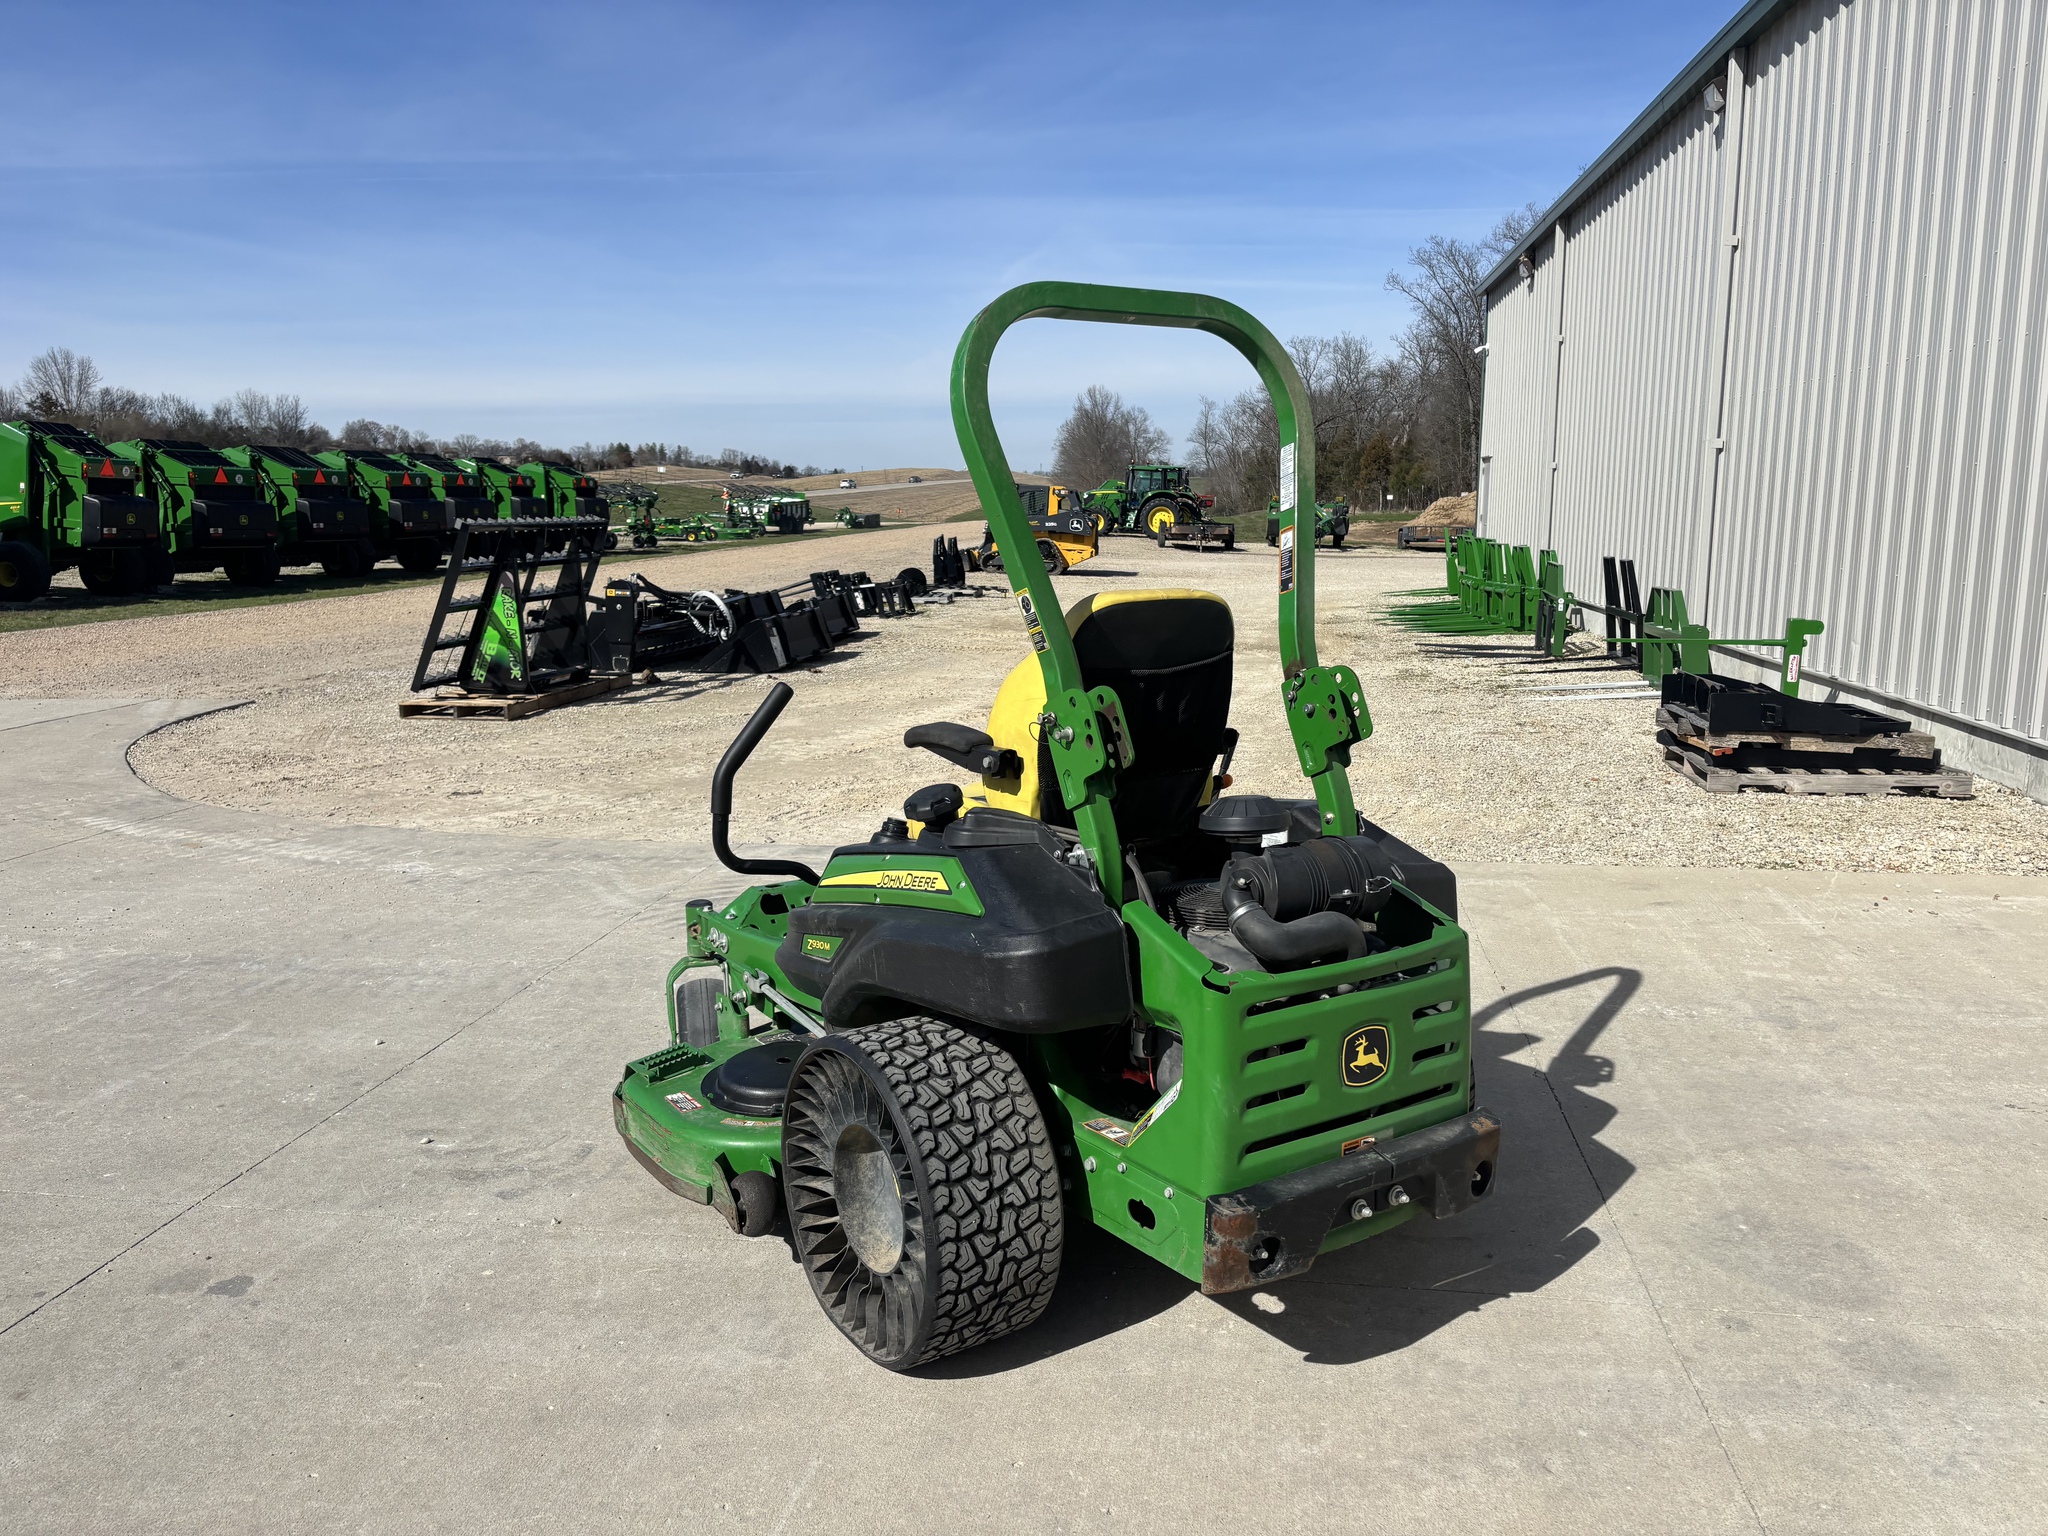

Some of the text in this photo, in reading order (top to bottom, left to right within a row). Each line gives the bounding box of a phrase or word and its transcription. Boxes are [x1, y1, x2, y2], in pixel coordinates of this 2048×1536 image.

[877, 872, 938, 888] JOHN DEERE
[807, 939, 830, 950] Z930M
